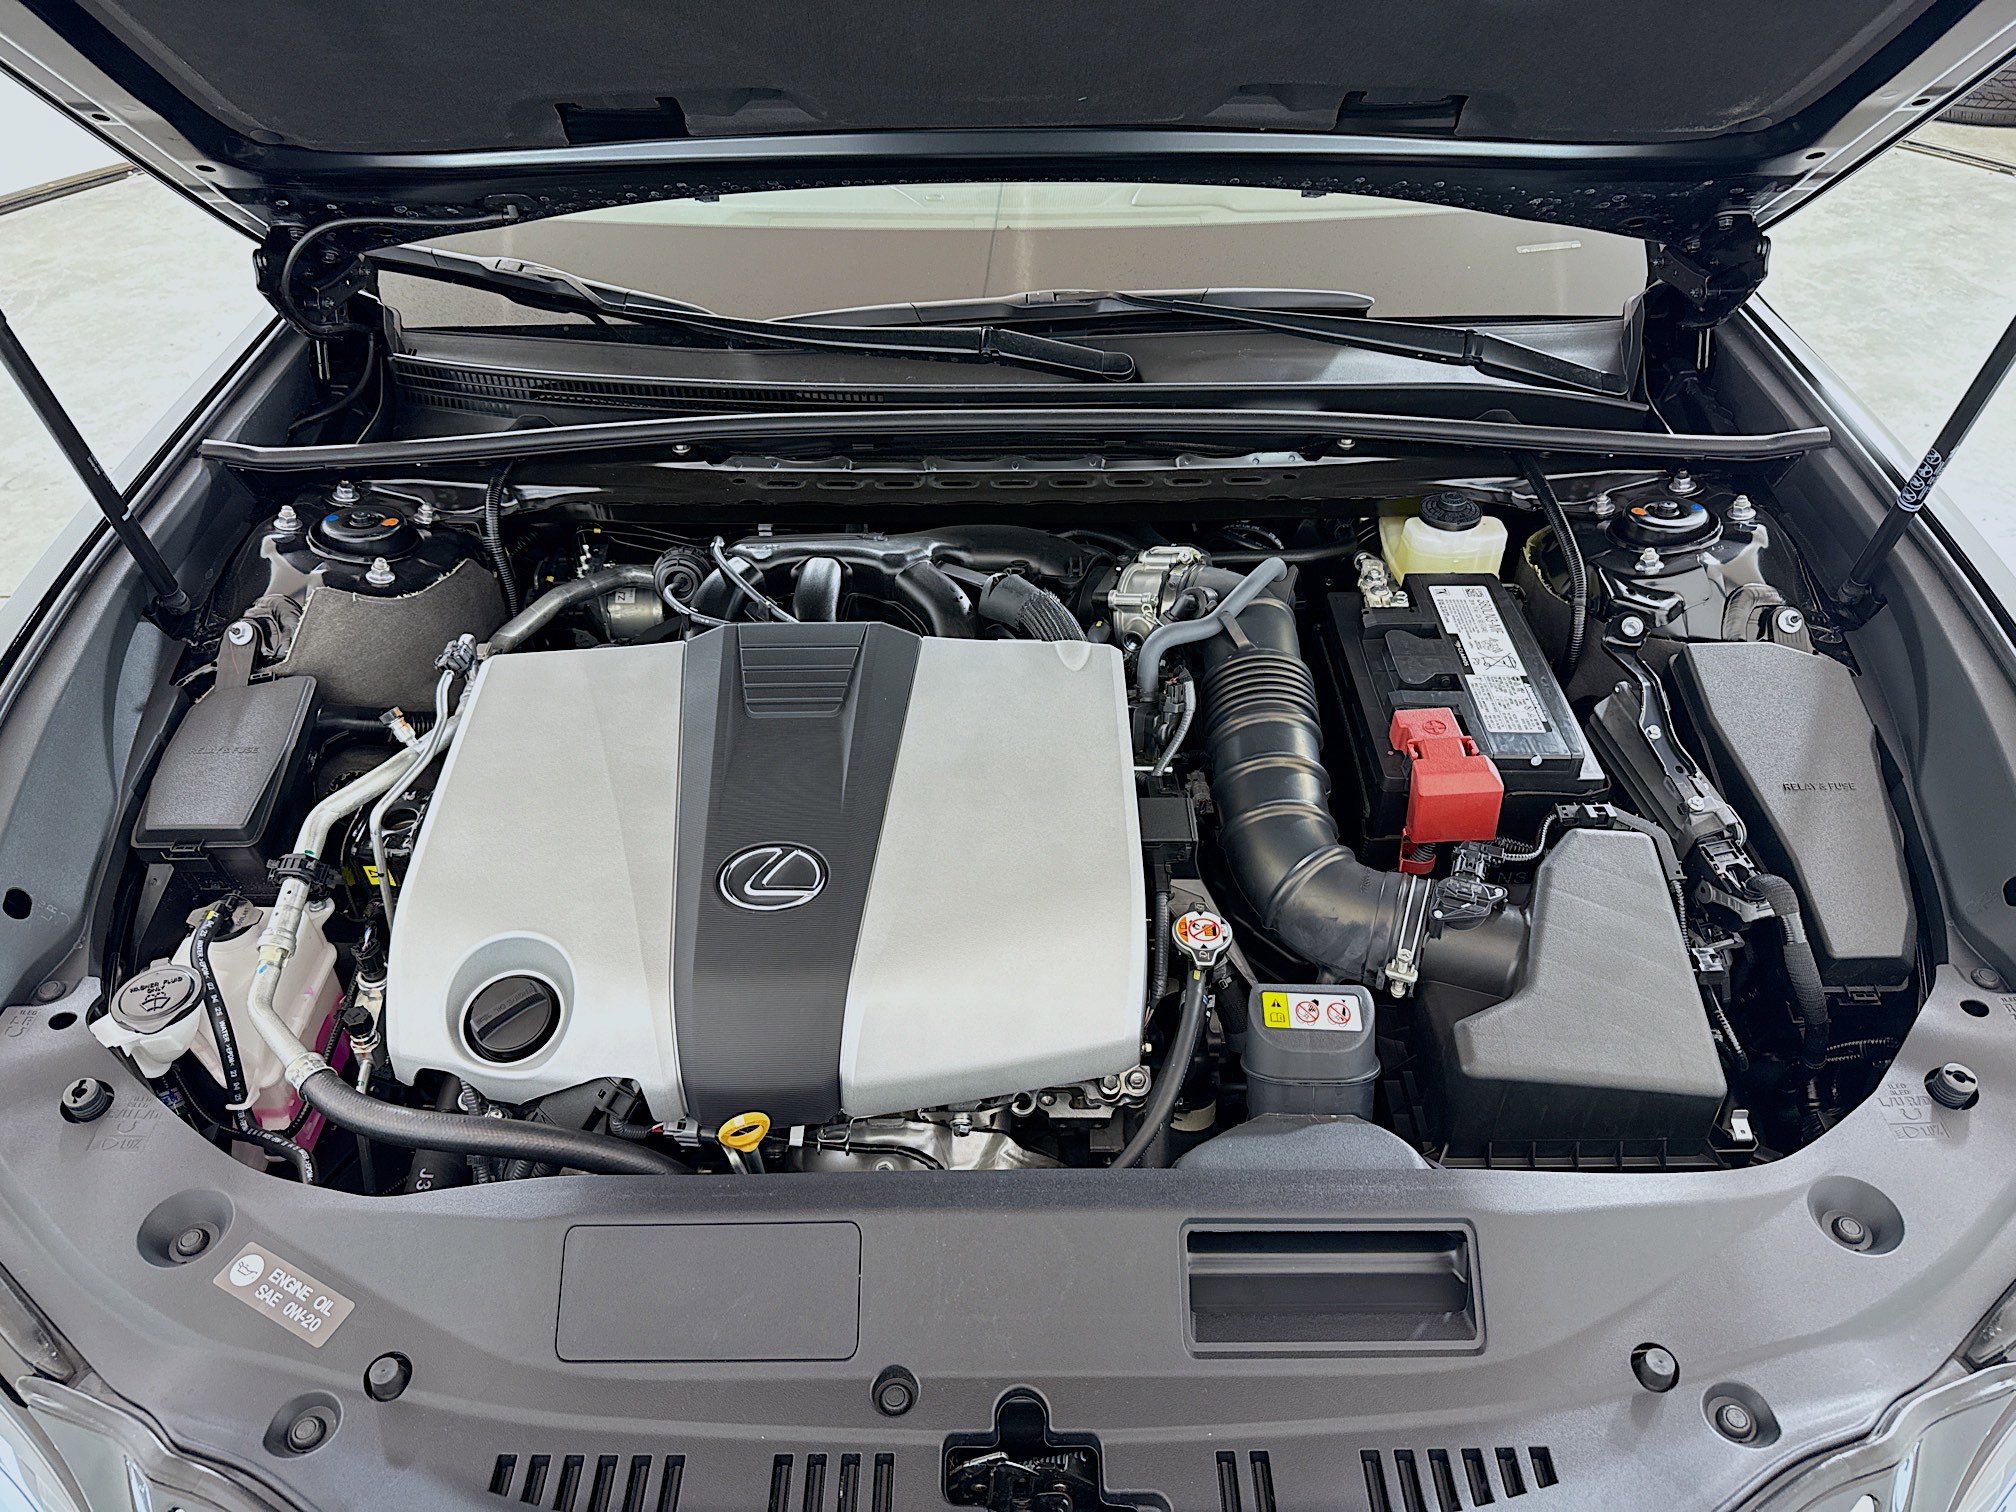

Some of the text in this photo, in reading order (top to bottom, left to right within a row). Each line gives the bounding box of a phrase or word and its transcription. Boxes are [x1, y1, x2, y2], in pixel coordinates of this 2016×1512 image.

[1782, 781, 1857, 792] RELAY & FUSE
[218, 1019, 231, 1043] WATER
[254, 1284, 322, 1333] SAE 0W-20
[267, 1267, 335, 1318] ENGINE OIL
